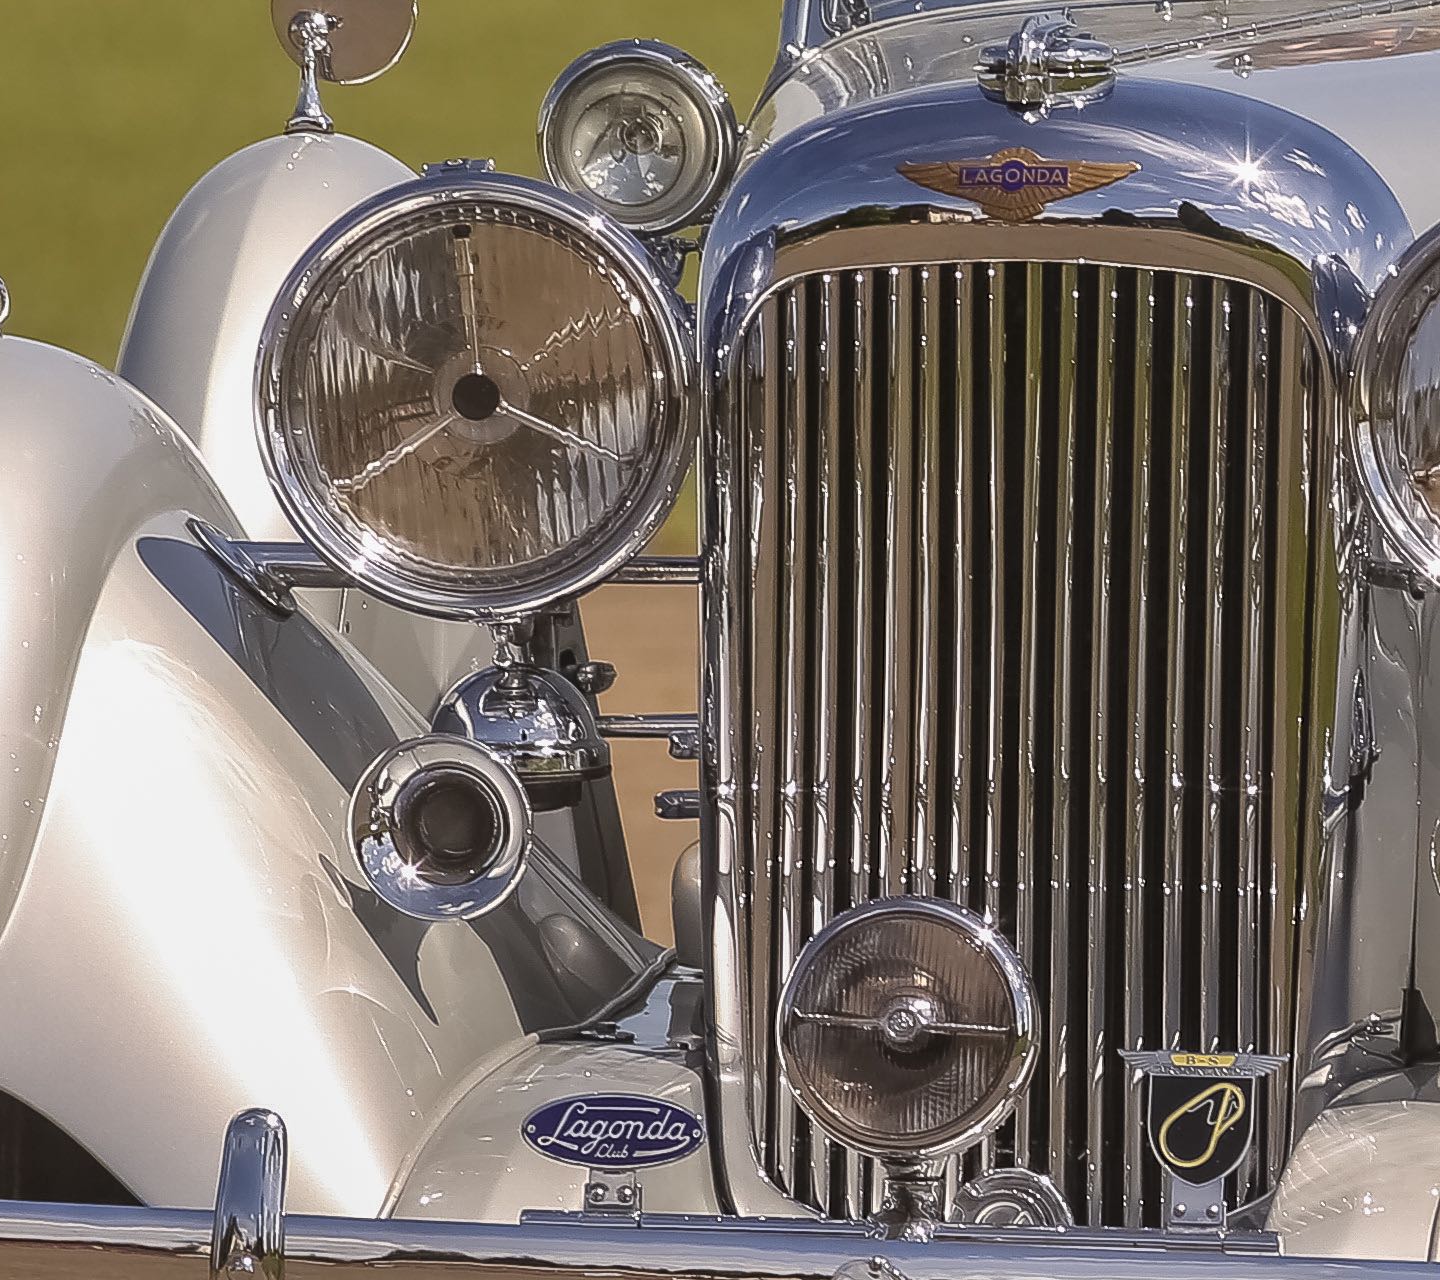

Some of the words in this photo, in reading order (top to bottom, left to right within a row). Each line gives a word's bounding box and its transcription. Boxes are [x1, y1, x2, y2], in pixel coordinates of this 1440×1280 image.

[961, 168, 1066, 185] LAGONDA
[537, 1101, 690, 1157] Lagonda
[594, 1143, 629, 1158] Club
